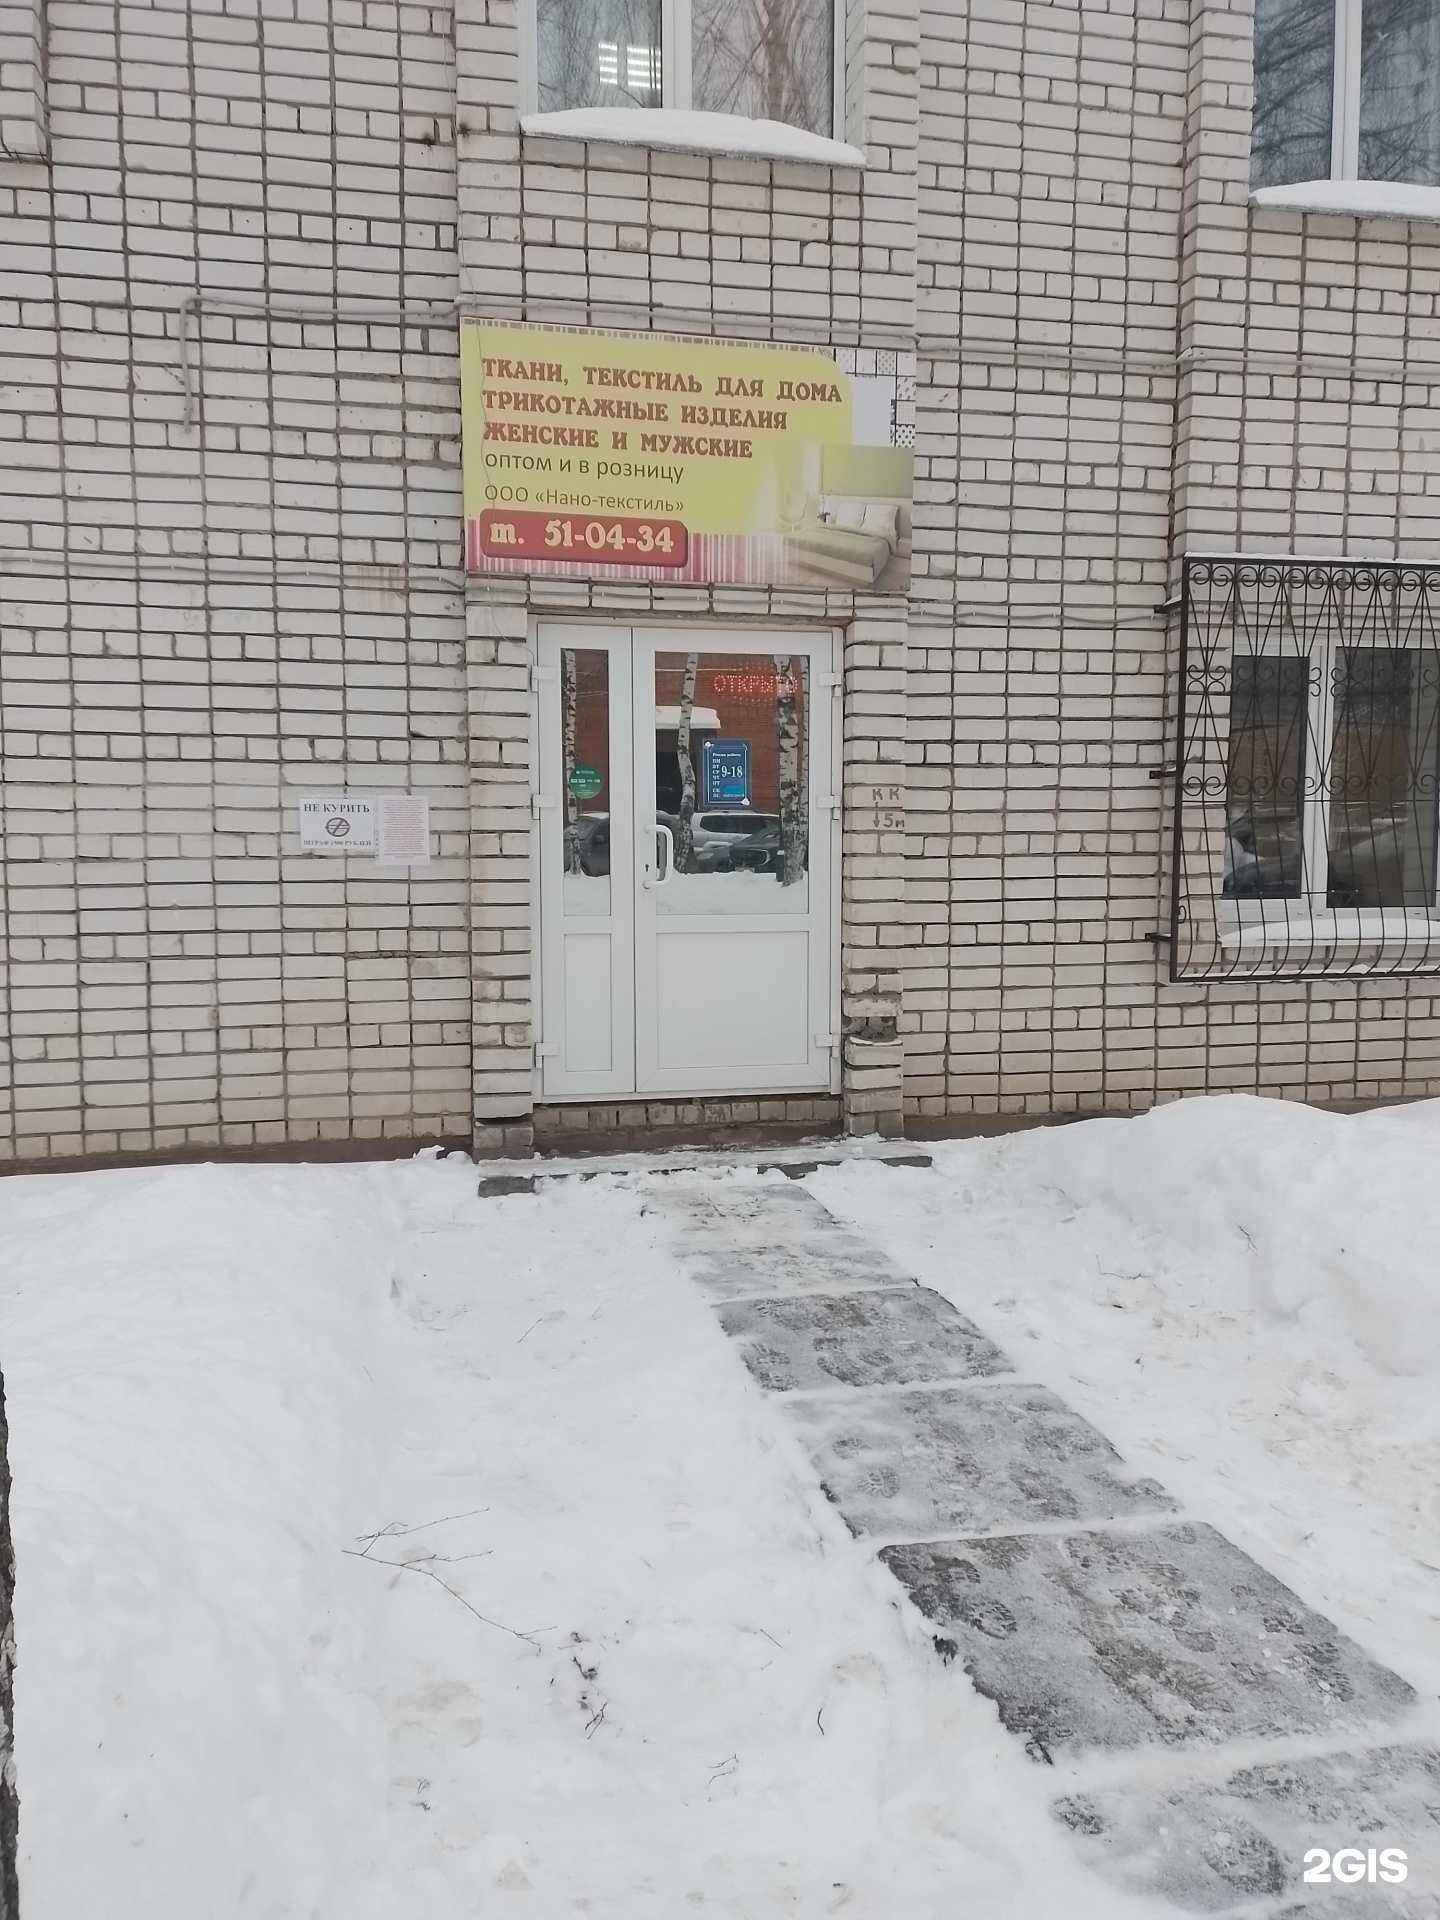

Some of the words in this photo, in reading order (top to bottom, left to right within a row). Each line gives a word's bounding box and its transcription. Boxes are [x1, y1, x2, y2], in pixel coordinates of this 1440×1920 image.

[482, 358, 569, 386] ТКАНИ,
[583, 366, 703, 394] ТЕКСТИЛЬ
[715, 376, 764, 398] ДЛЯ
[776, 380, 842, 402] ДОМА
[482, 390, 669, 422] ТРИКОТАЖНЫЕ
[681, 405, 787, 430] ИЗДЕЛИЯ
[483, 422, 599, 448] ЖЕНСКИЕ
[612, 432, 628, 450] И
[641, 433, 752, 458] МУЖСКИЕ
[485, 453, 552, 472] оптом
[559, 459, 571, 473] и
[579, 460, 590, 474] в
[597, 461, 684, 484] розницу
[485, 485, 528, 502] ООО
[535, 489, 684, 512] «Нано-текстиль»
[544, 518, 674, 553] 51-04-34
[721, 765, 743, 778] 9-18
[303, 803, 320, 813] НЕ
[323, 803, 371, 813] КУРИТЬ
